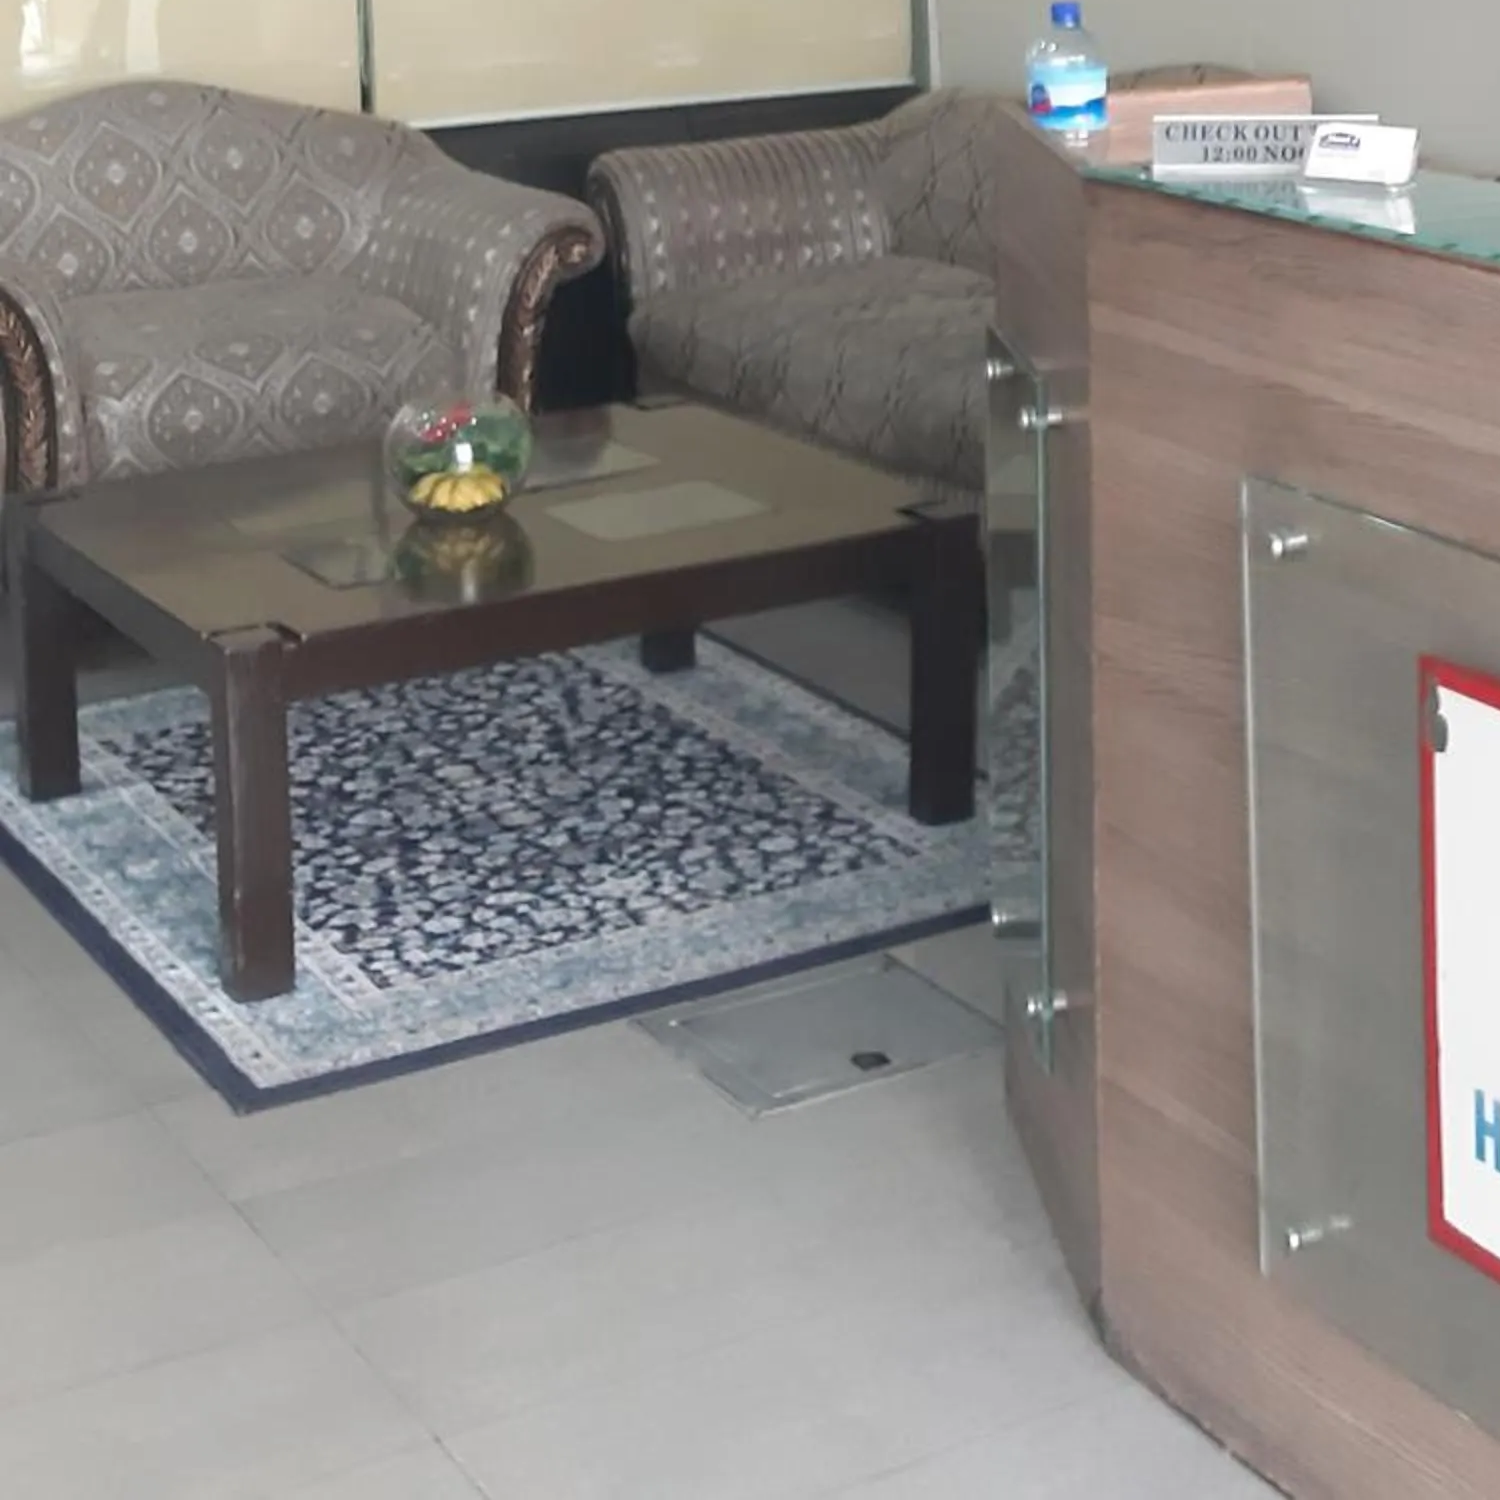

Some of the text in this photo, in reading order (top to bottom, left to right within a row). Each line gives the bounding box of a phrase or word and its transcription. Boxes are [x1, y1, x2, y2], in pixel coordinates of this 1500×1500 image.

[1165, 123, 1248, 143] CHECK
[1254, 123, 1302, 143] OUT
[1203, 145, 1258, 164] 12:00
